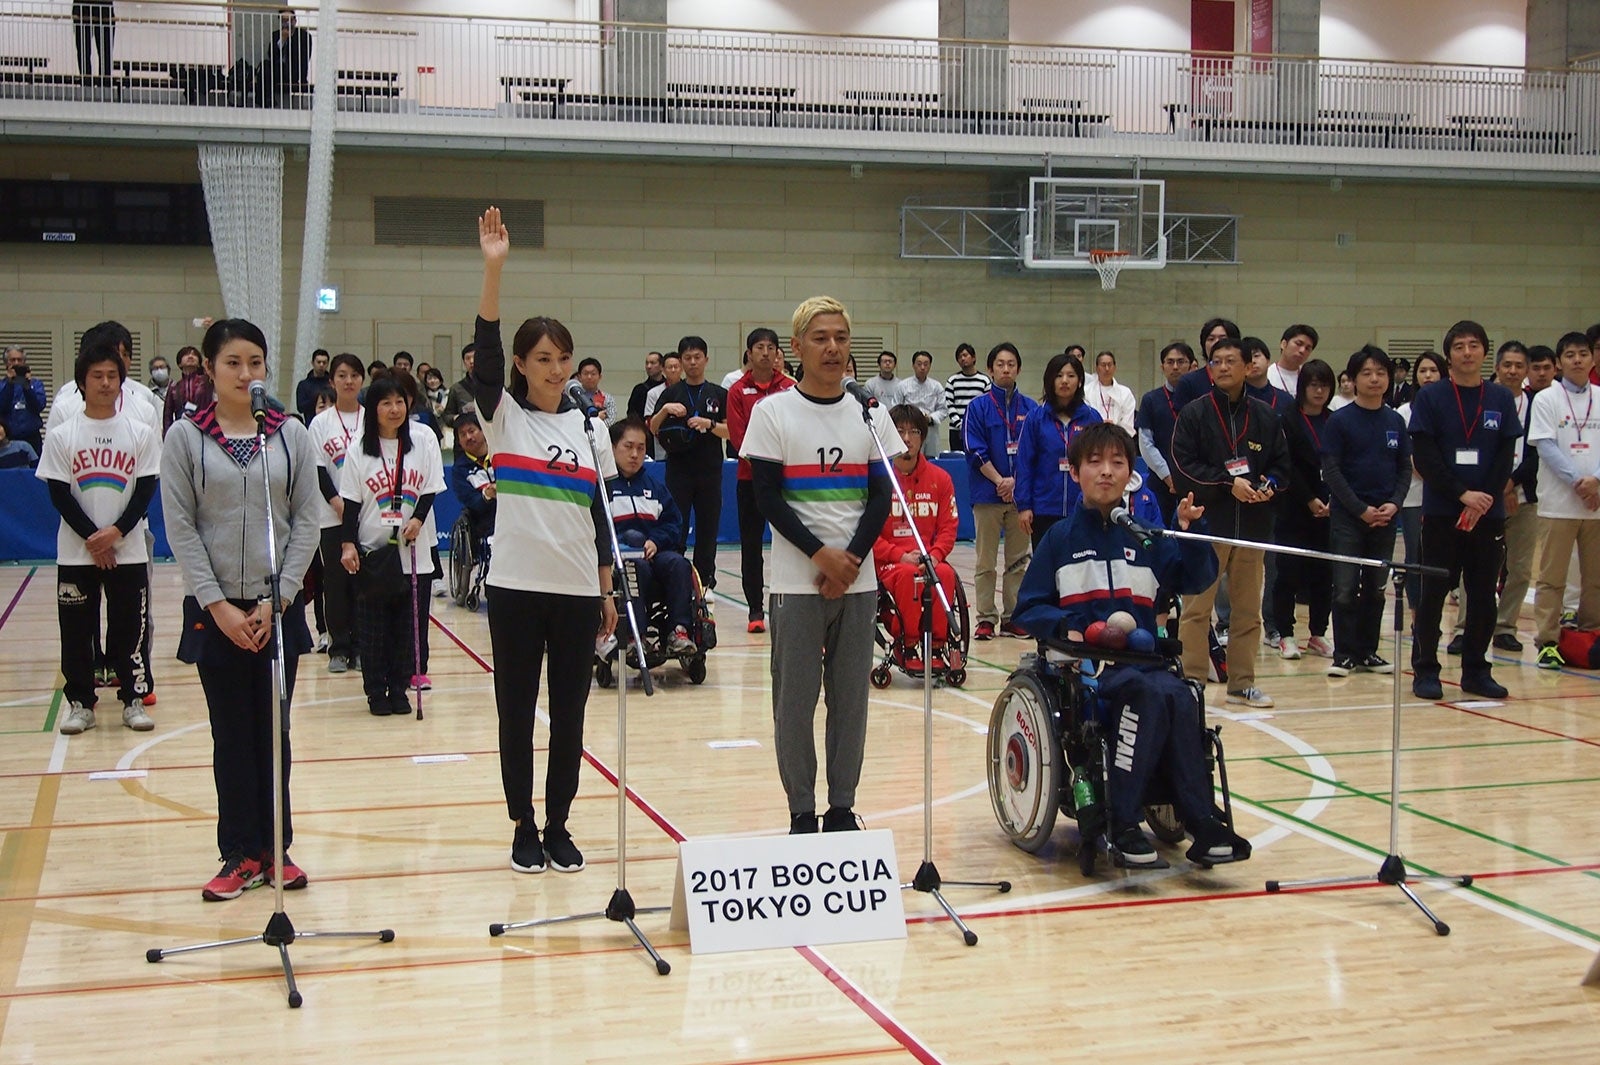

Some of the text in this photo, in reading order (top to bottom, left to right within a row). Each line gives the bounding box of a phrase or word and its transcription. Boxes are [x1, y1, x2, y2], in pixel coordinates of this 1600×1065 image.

[546, 445, 579, 473] 23
[817, 447, 843, 473] 12
[889, 501, 939, 517] UGBY
[1016, 710, 1037, 750] BOCCI
[1114, 704, 1139, 772] JAPAN
[691, 858, 893, 893] 2017 BOCCIA
[701, 889, 888, 923] TOKYO CUP
